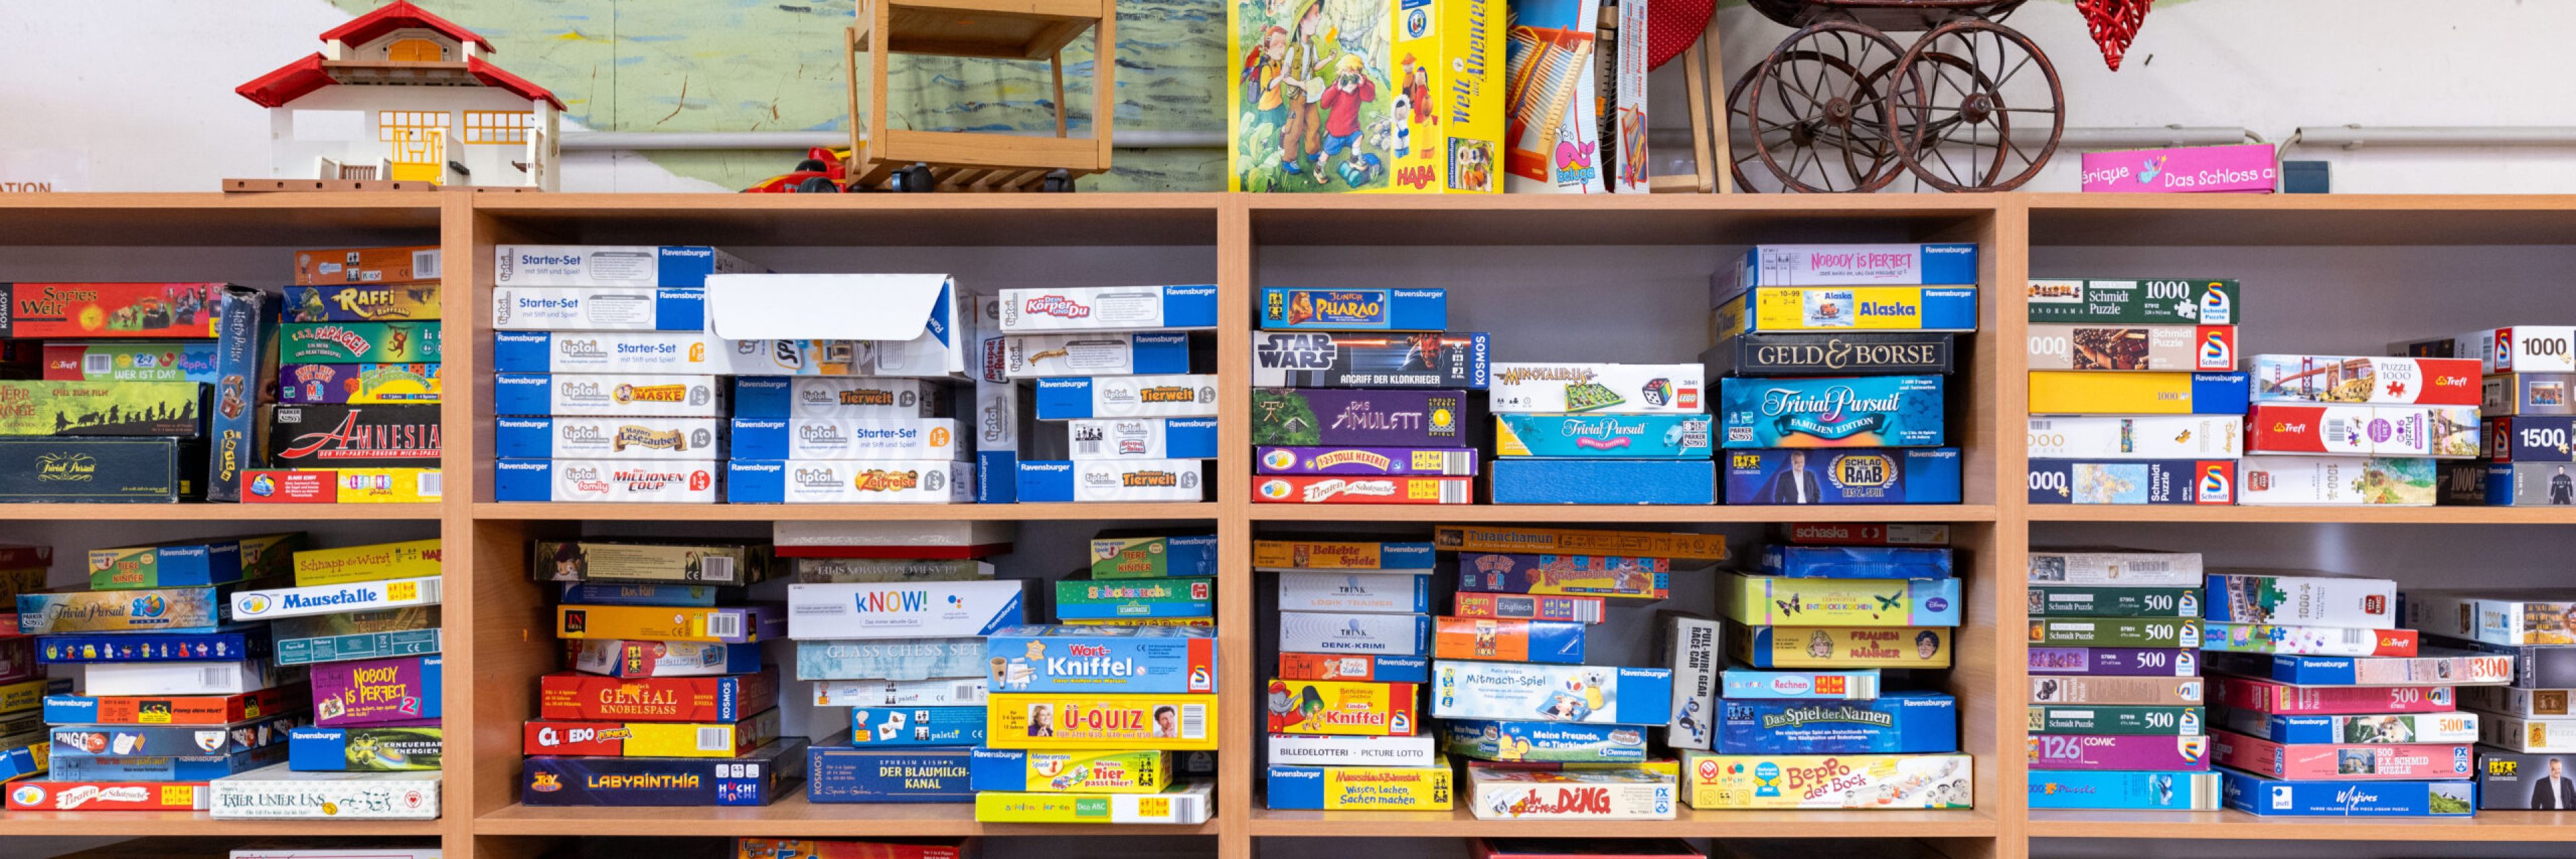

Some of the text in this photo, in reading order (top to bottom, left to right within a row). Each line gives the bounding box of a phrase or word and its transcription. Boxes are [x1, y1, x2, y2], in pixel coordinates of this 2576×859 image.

[1452, 78, 1470, 129] Welt
[1397, 164, 1436, 190] HABA
[1556, 167, 1594, 184] beluga
[2165, 170, 2257, 187] Das Schloss
[522, 256, 580, 264] Starter-Set
[1811, 253, 1854, 268] NOBODY
[43, 287, 97, 301] Sofies
[2089, 291, 2128, 302] Schmidt
[2145, 281, 2190, 299] 1000
[519, 298, 578, 307] Starter-Set
[1329, 293, 1362, 301] JUNIOR
[21, 301, 64, 315] Welt
[1316, 300, 1379, 321] PHARAO
[1860, 302, 1916, 316] Alaska
[2090, 303, 2121, 315] Puzzle
[617, 344, 676, 353] Starter-Set
[1258, 334, 1334, 350] STAR
[2522, 338, 2566, 355] 1000
[1258, 351, 1334, 368] WARS
[1475, 336, 1485, 385] KOSMOS
[1758, 339, 1935, 369] GELD & BÖRSE
[179, 354, 207, 370] Peppa
[2381, 363, 2412, 371] PUZZLE
[115, 370, 176, 379] WER IST DA?
[1341, 375, 1440, 384] ANGRIFF DER KLONKRIEGER
[1503, 368, 1587, 387] MINOTAURUS
[2195, 374, 2244, 383] Ravensburger
[2447, 376, 2467, 387] Trefl
[307, 384, 323, 396] MB
[635, 392, 682, 401] MASKE
[1141, 388, 1193, 401] Tierwelt
[840, 391, 894, 405] Tierwelt
[1762, 386, 1900, 421] Trivial Pursuit
[1332, 407, 1421, 430] AMULETT
[857, 429, 916, 438] Starter-Set
[2284, 423, 2305, 433] Trefl
[621, 432, 678, 447] Lesezauber
[2520, 429, 2565, 446] 1500
[1909, 450, 1956, 458] Ravensburger
[1845, 458, 1881, 466] SCHLAG
[613, 471, 684, 482] MILLIONEN
[860, 472, 916, 489] Zeitreise
[1123, 472, 1175, 486] Tierwelt
[1844, 467, 1882, 483] RAAB
[578, 481, 608, 493] family
[629, 482, 665, 491] COUP
[2151, 464, 2160, 501] Schmidt
[2161, 472, 2169, 501] Puzzle
[1796, 527, 1848, 538] schaska
[160, 548, 204, 557] Ravensburger
[1313, 546, 1360, 555] Beliebte
[1384, 546, 1430, 554] Ravensburger
[301, 553, 391, 573] Schnapp die Wurst
[1340, 556, 1376, 566] Spiele
[282, 589, 377, 609] Mausefalle
[855, 591, 927, 613] kNOW!
[2144, 595, 2172, 611] 500
[50, 603, 125, 623] Trivial Pursuit
[1499, 602, 1532, 611] Englisch
[2076, 632, 2094, 640] Puzzle
[2145, 625, 2174, 640] 500
[1689, 627, 1701, 668] RACE CAR
[2391, 638, 2408, 647] Trefl
[827, 644, 979, 659] GLASS CHESS SET
[1069, 645, 1111, 656] Wort-
[1701, 628, 1712, 673] PULL-WIRE
[1048, 658, 1132, 676] Kniffel
[1377, 658, 1425, 666] Ravensburger
[2137, 653, 2165, 668] 500
[2304, 661, 2348, 669] Ravensburger
[1621, 670, 1669, 678] Ravensburger
[2475, 658, 2508, 677] 300
[354, 666, 398, 689] NOBODY
[1466, 674, 1546, 687] Mitmach-Spiel
[1774, 680, 1808, 689] Rechnen
[2391, 689, 2418, 703] 500
[1904, 699, 1952, 707] Ravensburger
[601, 705, 676, 715] KNOBELSPASS
[1065, 705, 1143, 729] Ü-QUIZ
[1326, 711, 1385, 725] Kniffel
[1765, 709, 1891, 725] Das Spiel der Namen
[2145, 713, 2174, 727] 500
[2290, 718, 2329, 727] Ravensburger
[2440, 719, 2463, 731] 500
[292, 731, 341, 740] Ravensburger
[538, 727, 594, 746] CLUEDO
[1534, 731, 1600, 740] Meine Freunde,
[2084, 738, 2115, 746] COMIC
[973, 750, 1023, 759] Ravensburger
[2041, 738, 2080, 758] 126
[880, 767, 970, 777] DER BLAUMILCH-
[1093, 768, 1124, 779] Tier
[1272, 770, 1320, 778] Ravensburger
[1787, 758, 1849, 789] Beppo
[2378, 766, 2411, 774] PUZZLE
[905, 779, 941, 789] KANAL
[1085, 779, 1112, 787] passt
[1804, 774, 1866, 800] der Bock
[1340, 795, 1415, 805] Sachen machen
